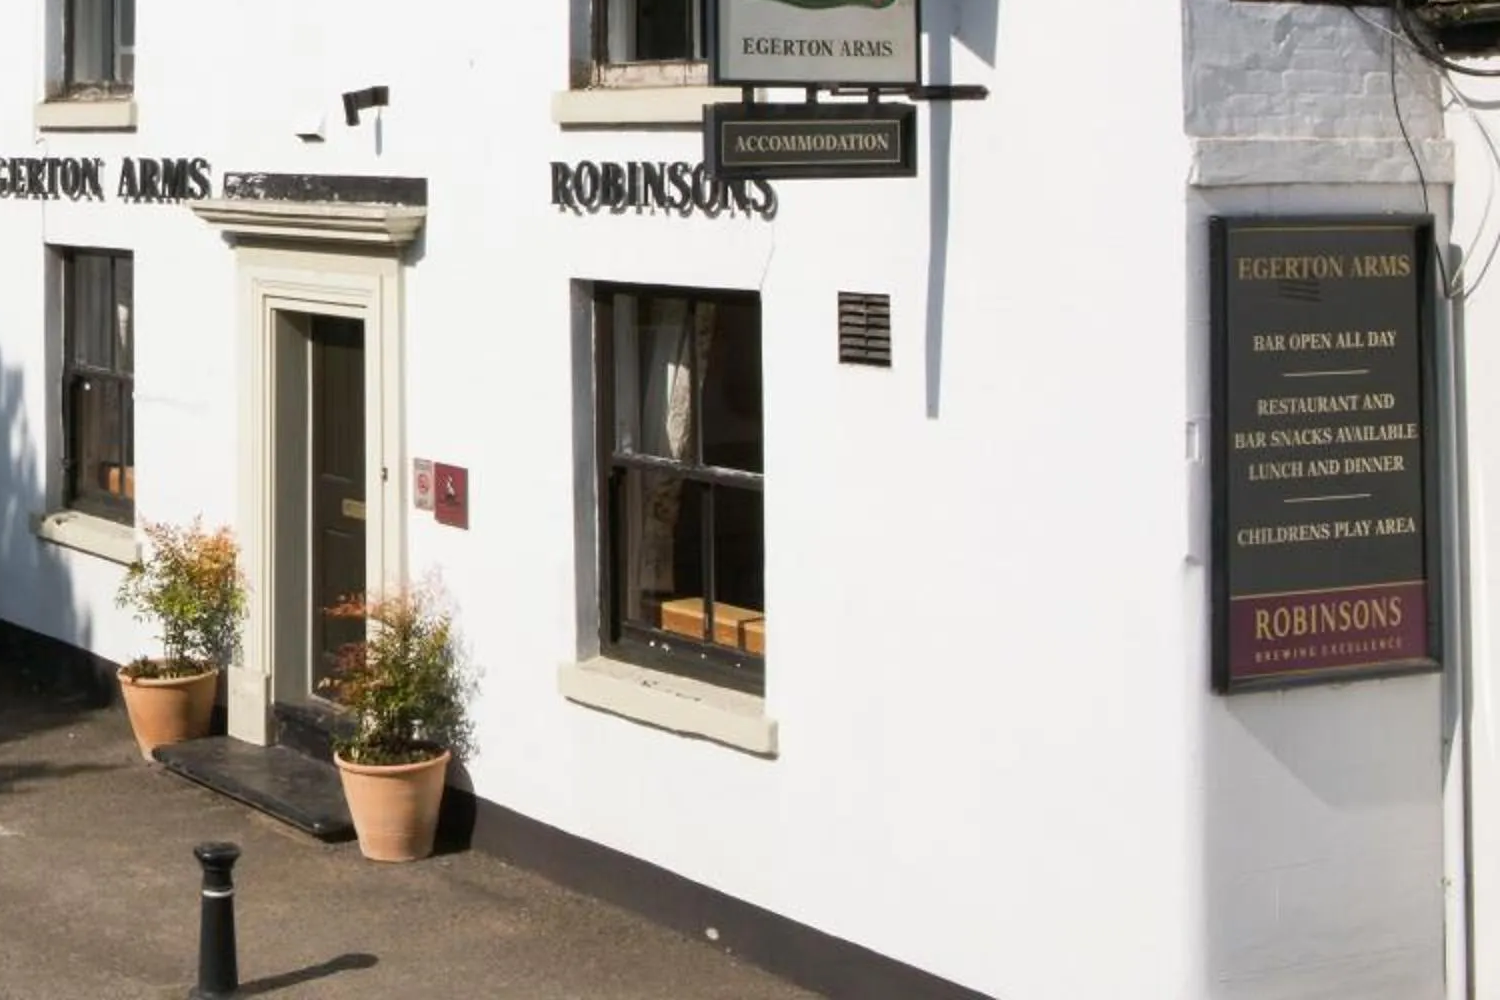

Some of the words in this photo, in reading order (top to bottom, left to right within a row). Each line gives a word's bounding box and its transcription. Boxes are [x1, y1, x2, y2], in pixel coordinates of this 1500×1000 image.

[742, 37, 833, 57] EGERTON
[838, 39, 893, 57] ARMS
[735, 133, 890, 152] ACCOMMODATION
[117, 157, 212, 201] ARMS
[1238, 255, 1345, 280] EGERTON
[1350, 254, 1411, 277] ARMS
[1253, 335, 1286, 351] BAR
[1289, 332, 1331, 350] OPEN
[1335, 331, 1364, 348] ALL
[1367, 329, 1397, 346] DAY
[1257, 395, 1358, 416] RESTAURANT
[1362, 393, 1395, 410] AND
[1234, 432, 1268, 449] BAR
[1270, 427, 1333, 447] SNACKS
[1336, 423, 1418, 444] AVAILABLE
[1248, 460, 1303, 481] LUNCH
[1307, 458, 1341, 477] AND
[1344, 455, 1405, 474] DINNER
[1237, 523, 1331, 545] CHILDRENS
[1334, 520, 1372, 538] PLAY
[1375, 517, 1416, 535] AREA
[1256, 597, 1402, 640] ROBINSONS
